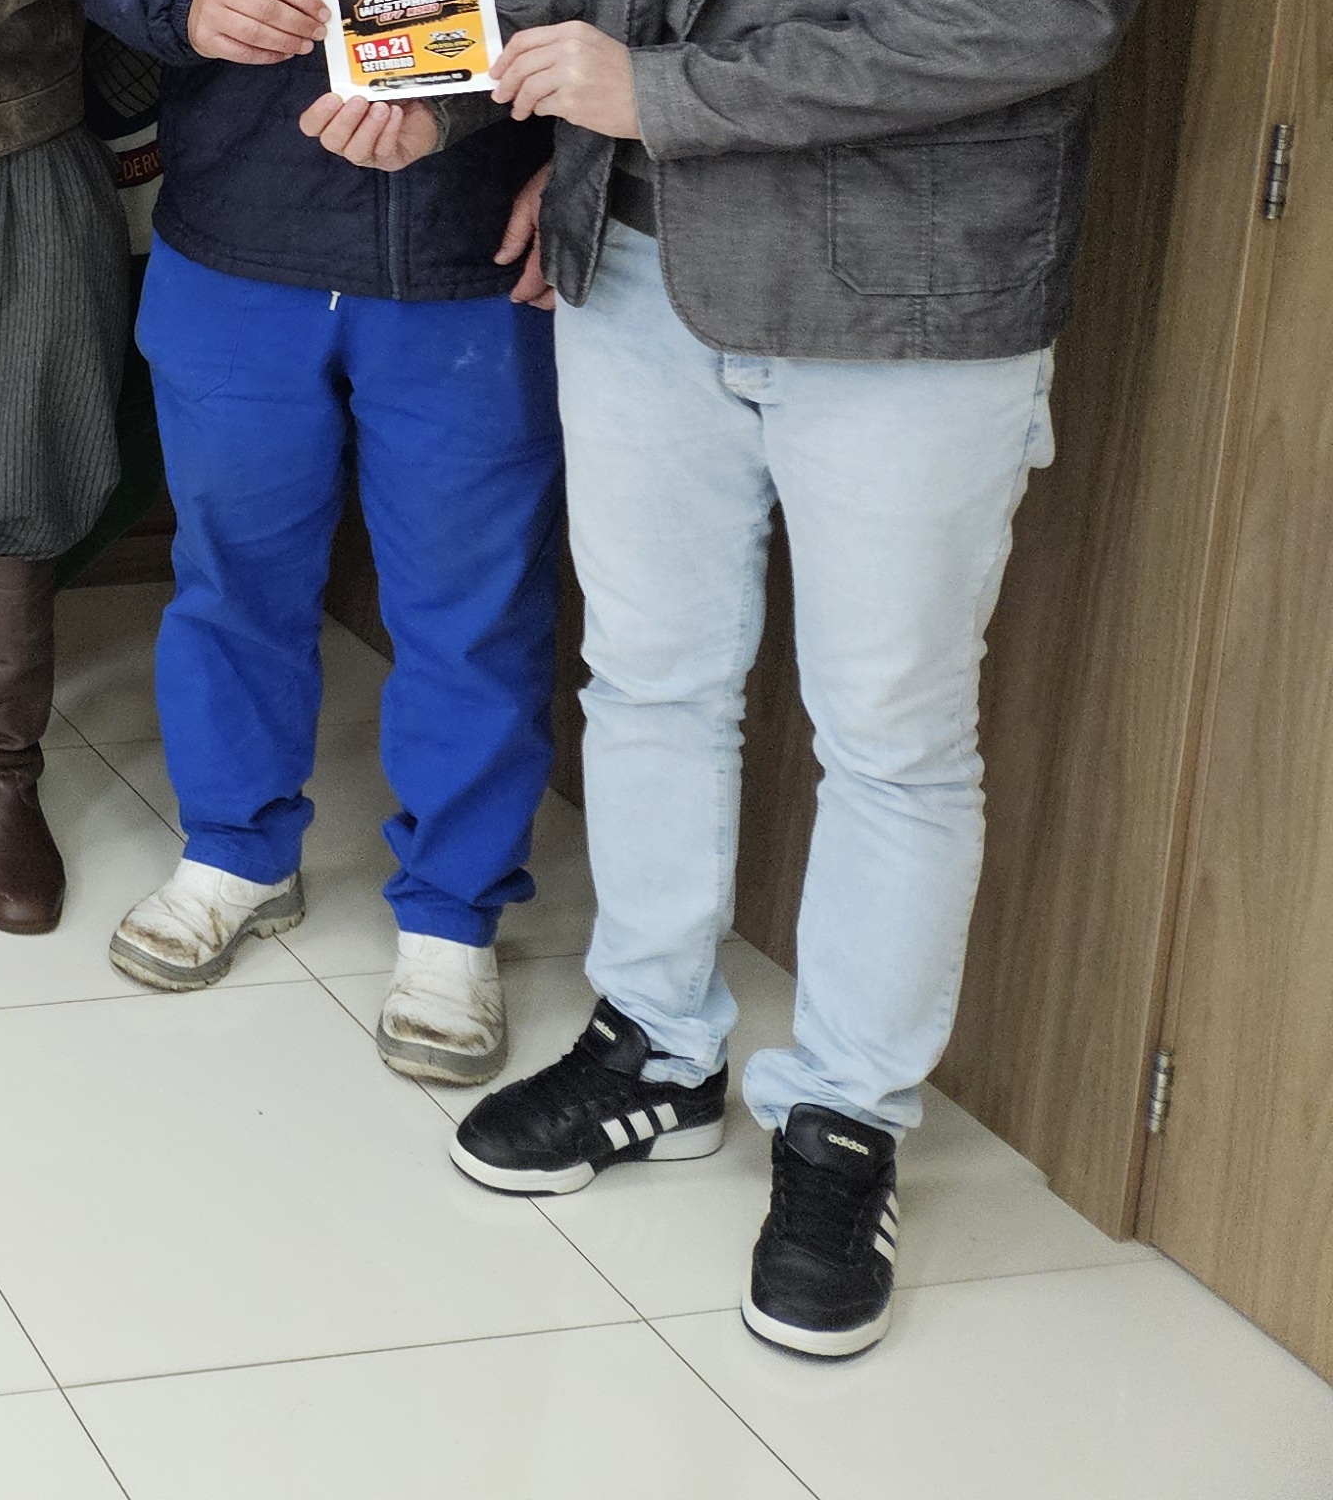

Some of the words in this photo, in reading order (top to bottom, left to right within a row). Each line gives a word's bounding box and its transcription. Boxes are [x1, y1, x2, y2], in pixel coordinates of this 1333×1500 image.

[355, 42, 377, 61] 19
[378, 45, 389, 57] a
[389, 36, 411, 54] 21
[827, 1133, 869, 1156] adidas
